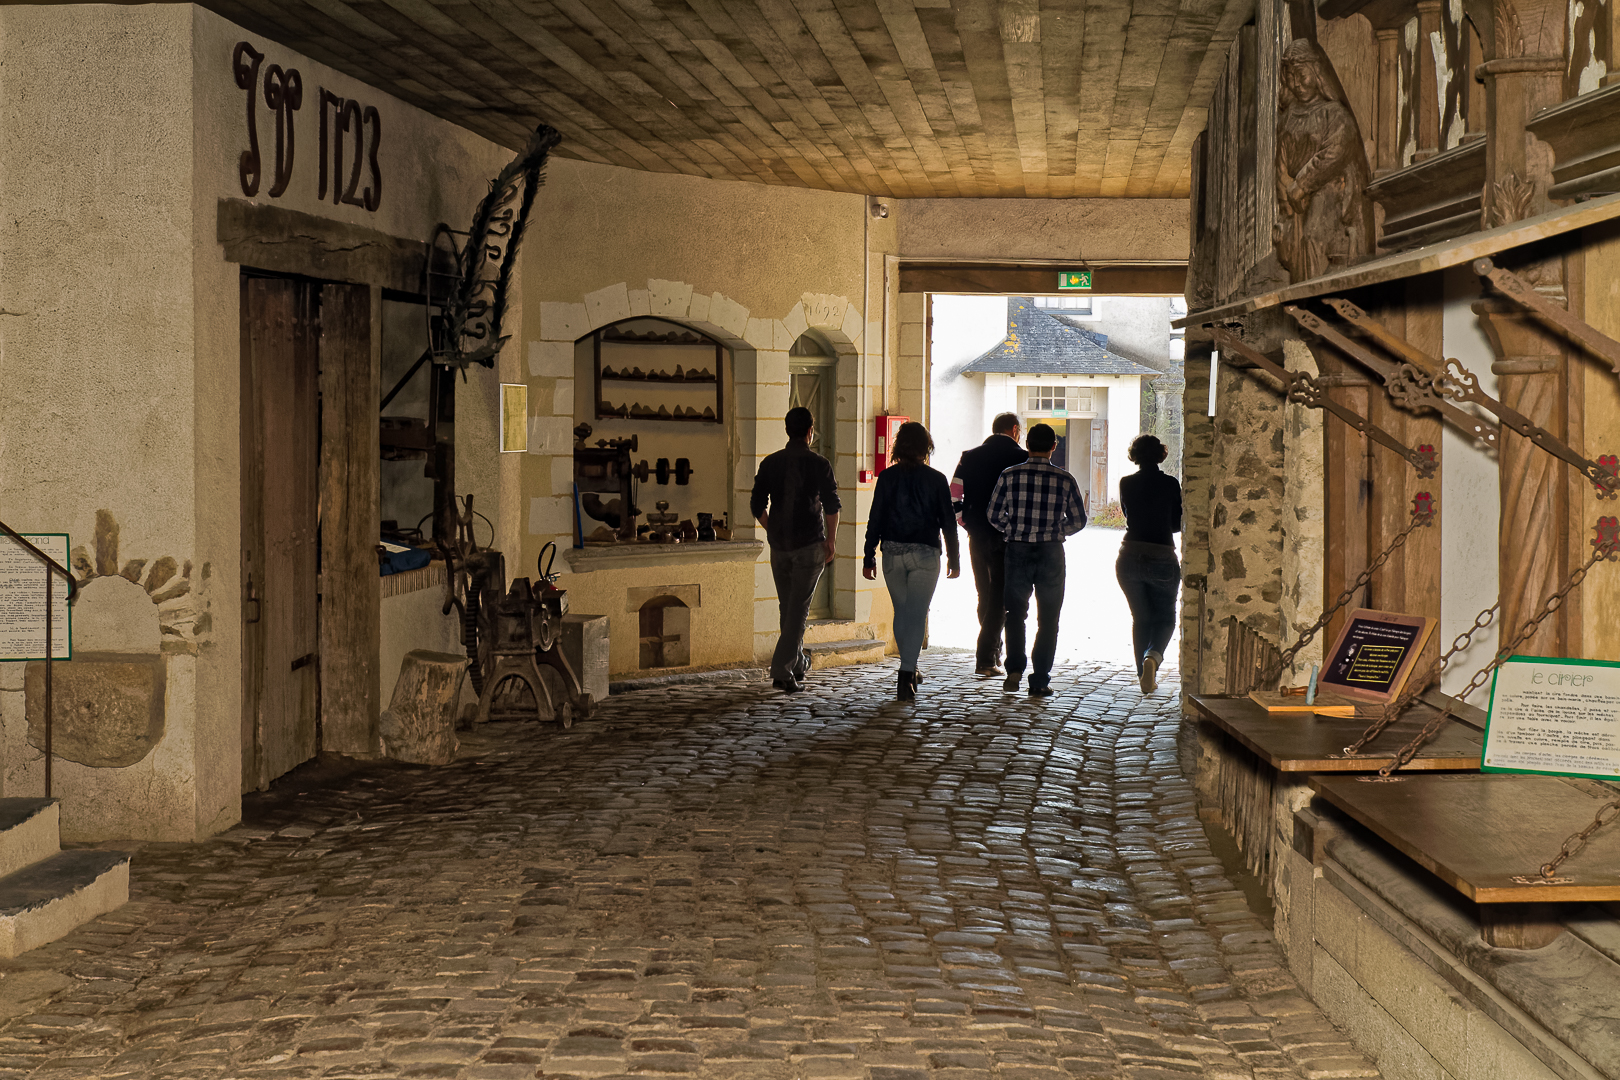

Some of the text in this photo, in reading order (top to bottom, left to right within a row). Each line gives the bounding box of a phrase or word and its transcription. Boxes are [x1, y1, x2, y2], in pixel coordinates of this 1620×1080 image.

[808, 303, 840, 321] 1692
[1531, 668, 1594, 687] le cirier
